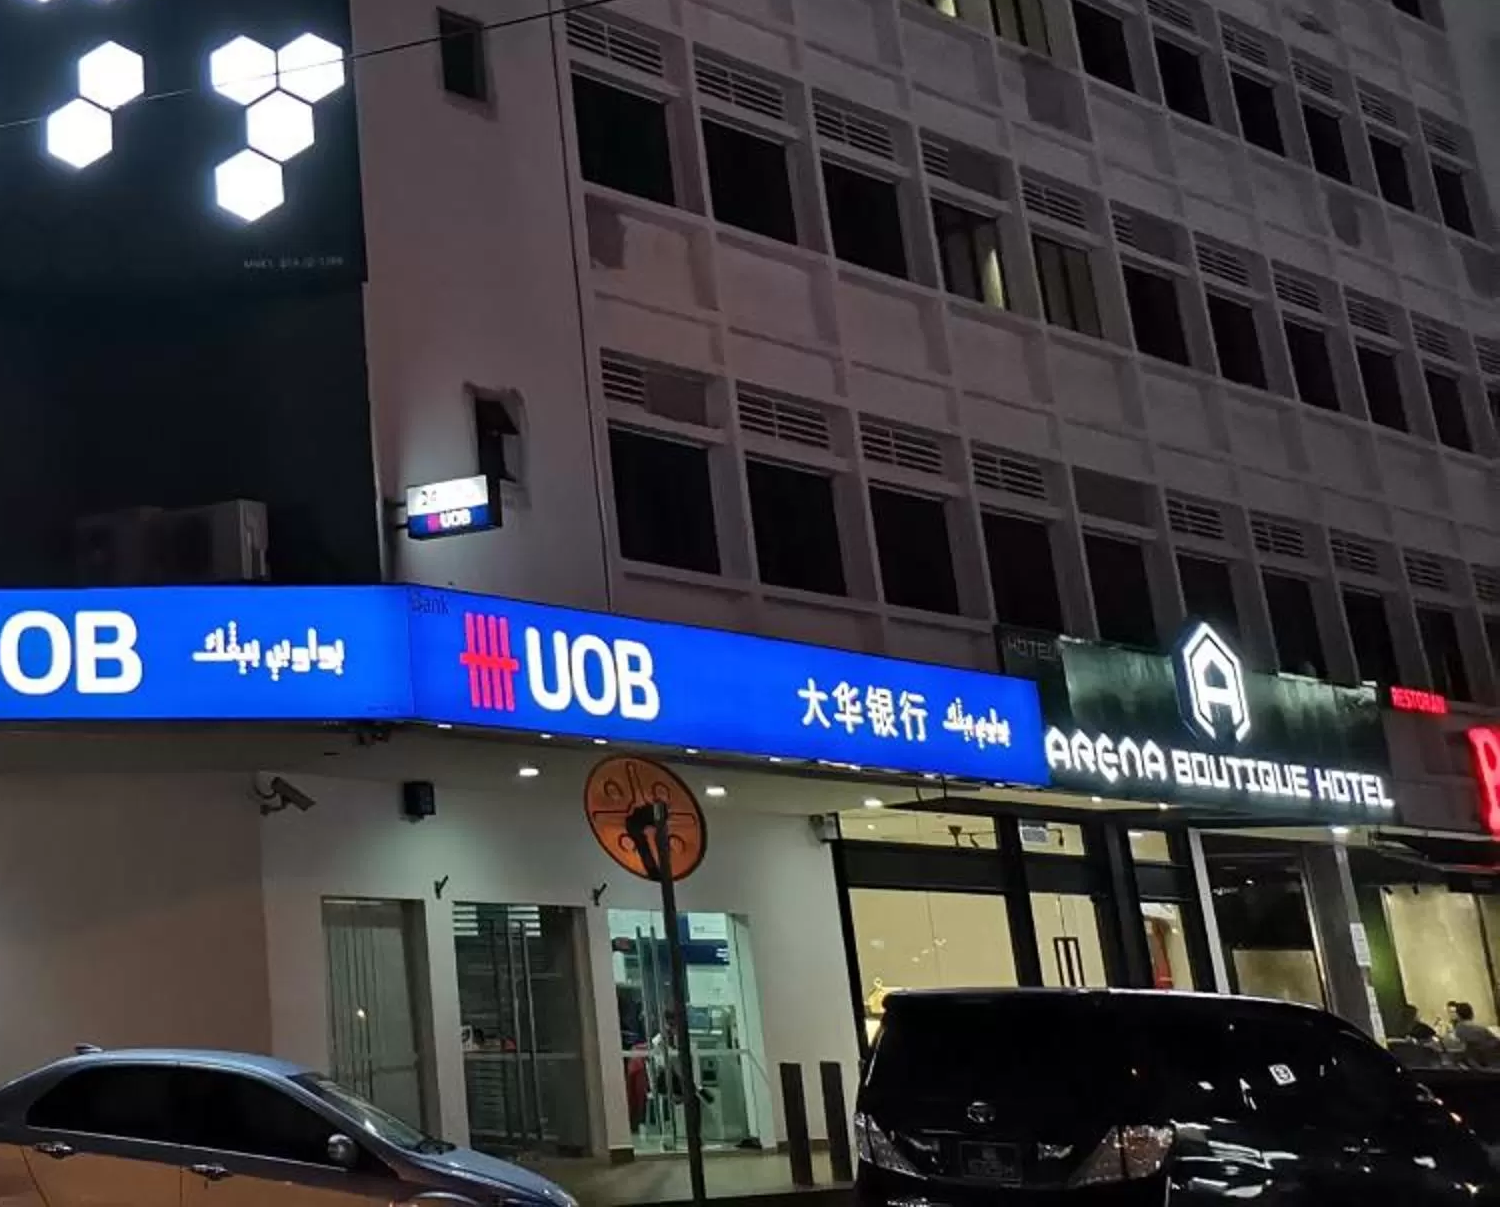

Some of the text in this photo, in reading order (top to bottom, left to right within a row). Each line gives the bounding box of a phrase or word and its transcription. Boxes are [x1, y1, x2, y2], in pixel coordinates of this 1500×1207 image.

[439, 508, 471, 528] UOB
[525, 627, 660, 721] UOB
[797, 677, 929, 742] 大华银行
[1044, 725, 1396, 809] ARENA BOUTIQUE HOTEL
